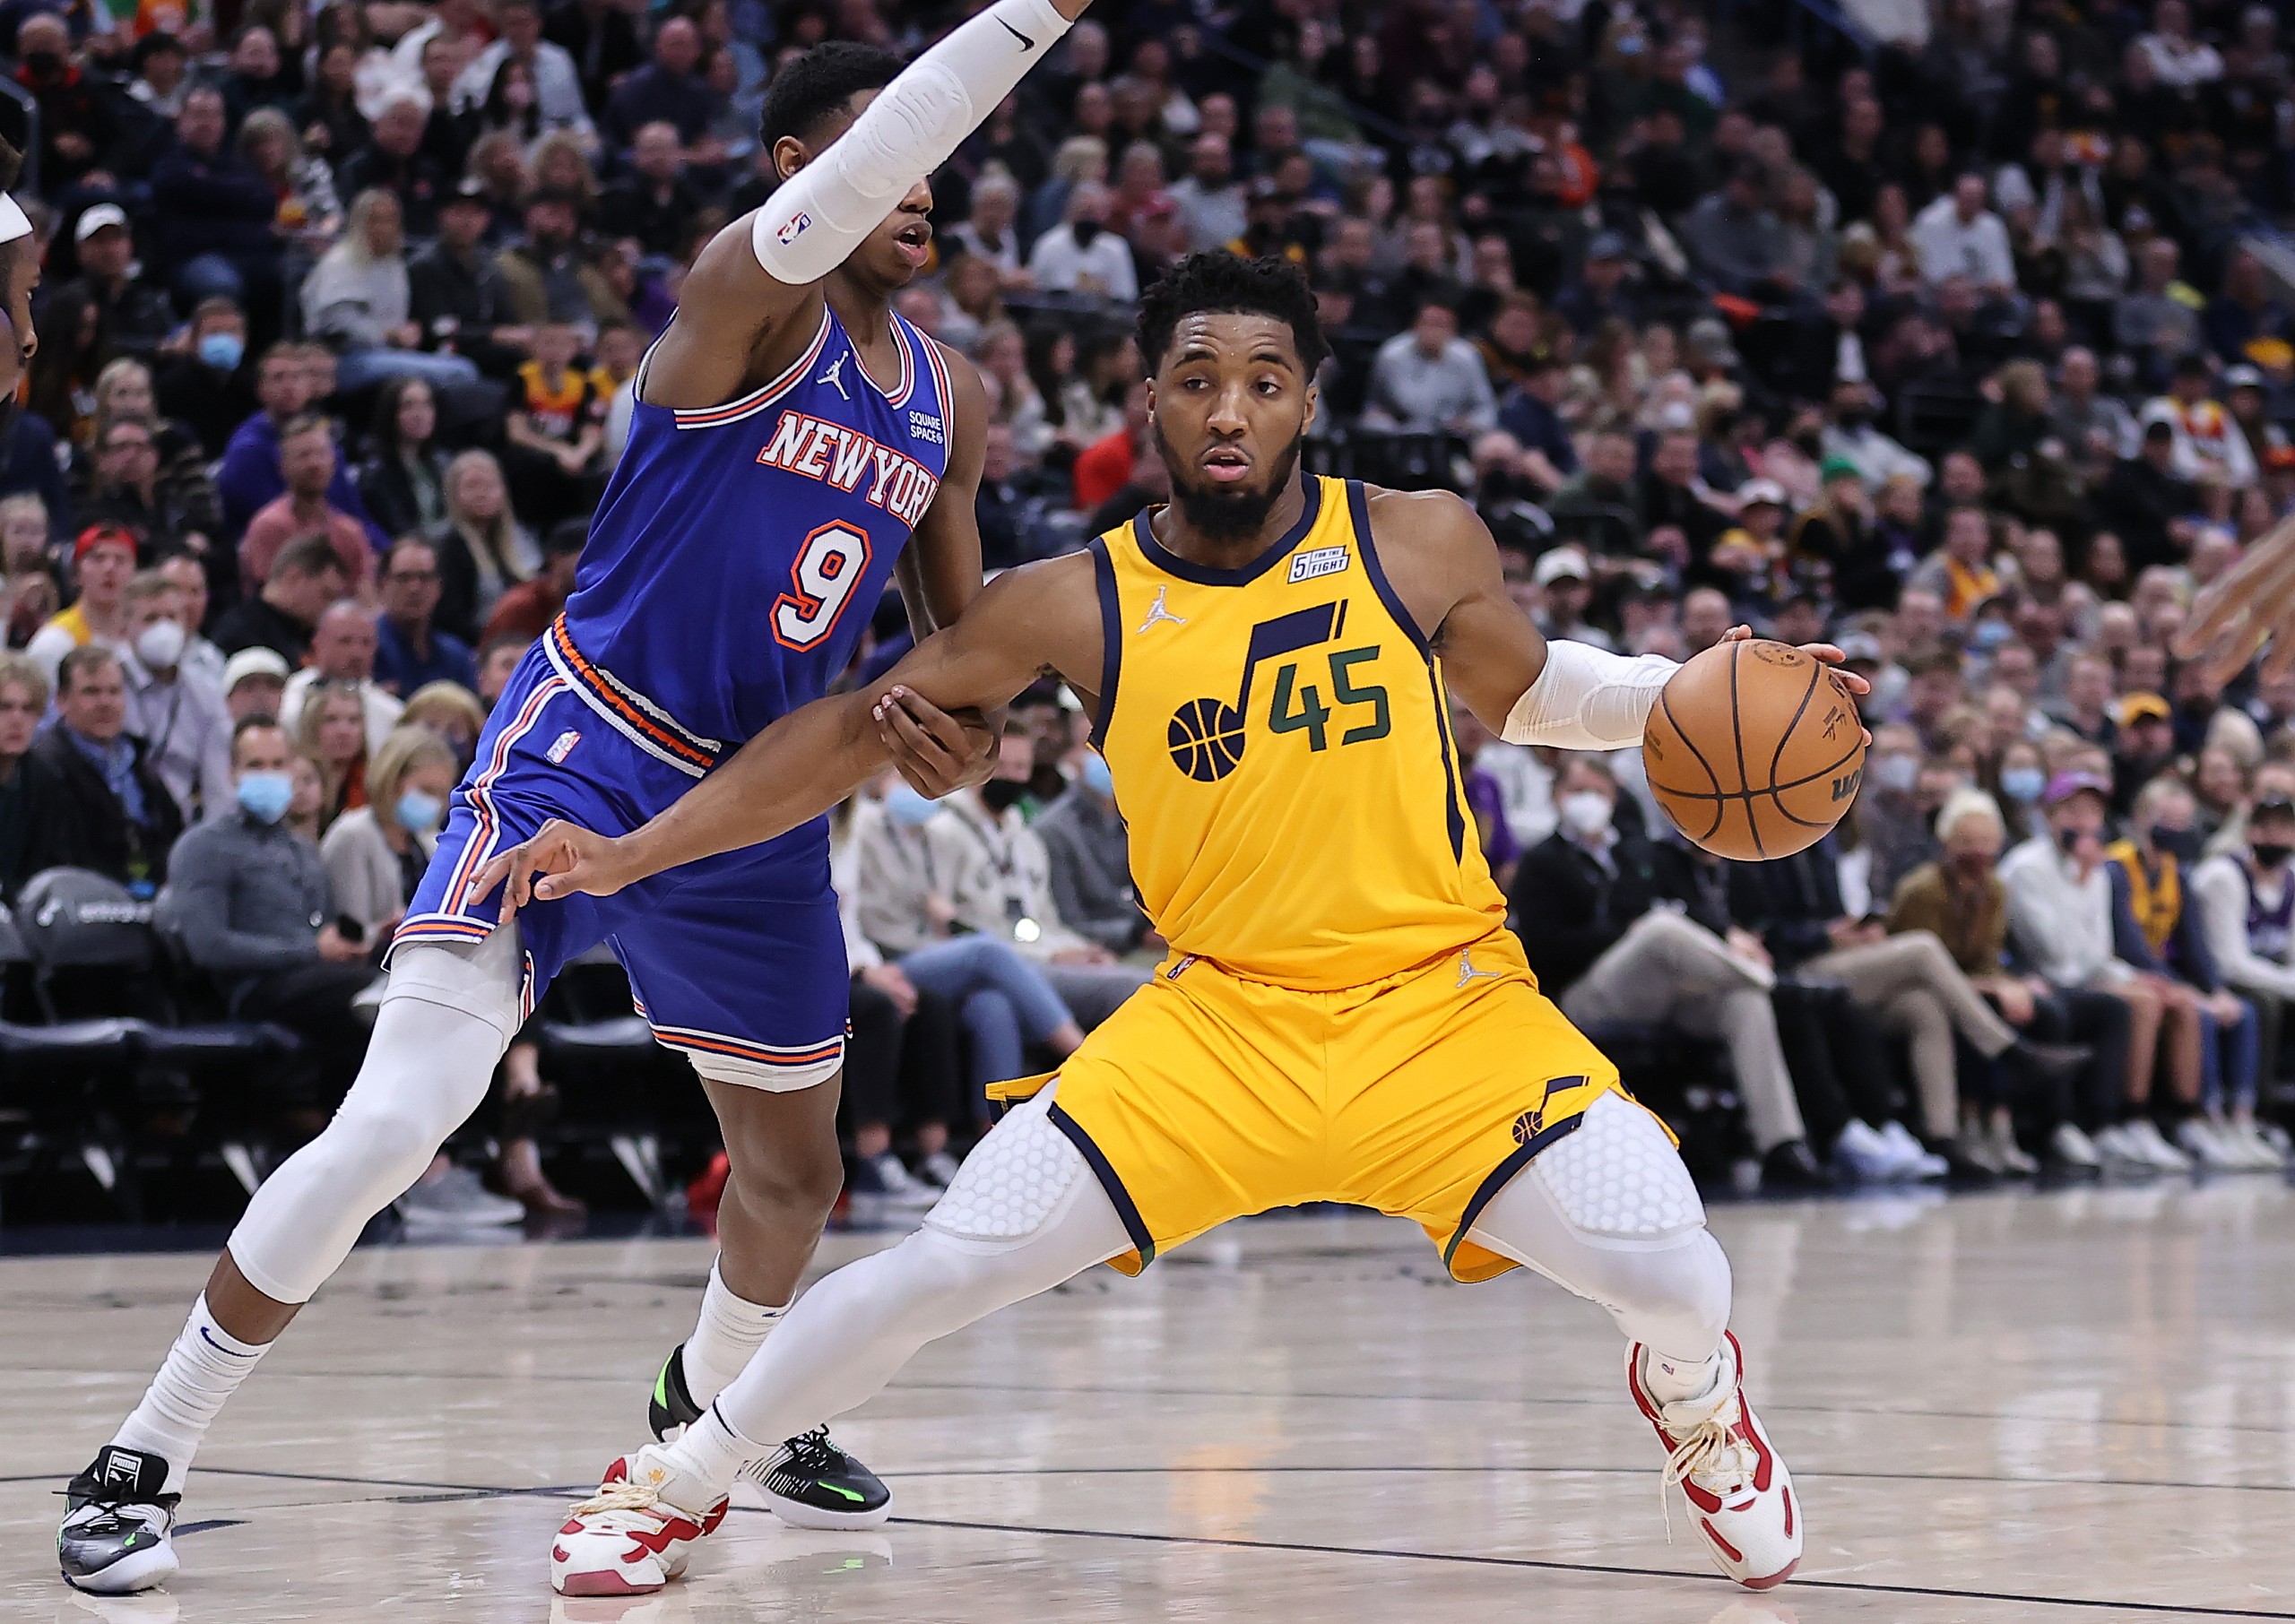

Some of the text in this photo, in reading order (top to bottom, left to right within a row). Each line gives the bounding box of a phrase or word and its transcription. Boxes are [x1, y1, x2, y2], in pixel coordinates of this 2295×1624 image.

[909, 410, 941, 430] SQUARE
[910, 425, 937, 443] SPACE
[757, 410, 876, 493] NEW
[1294, 556, 1308, 579] 5
[1312, 559, 1345, 574] FIGHT
[769, 519, 872, 652] 9
[1269, 644, 1391, 752] 45
